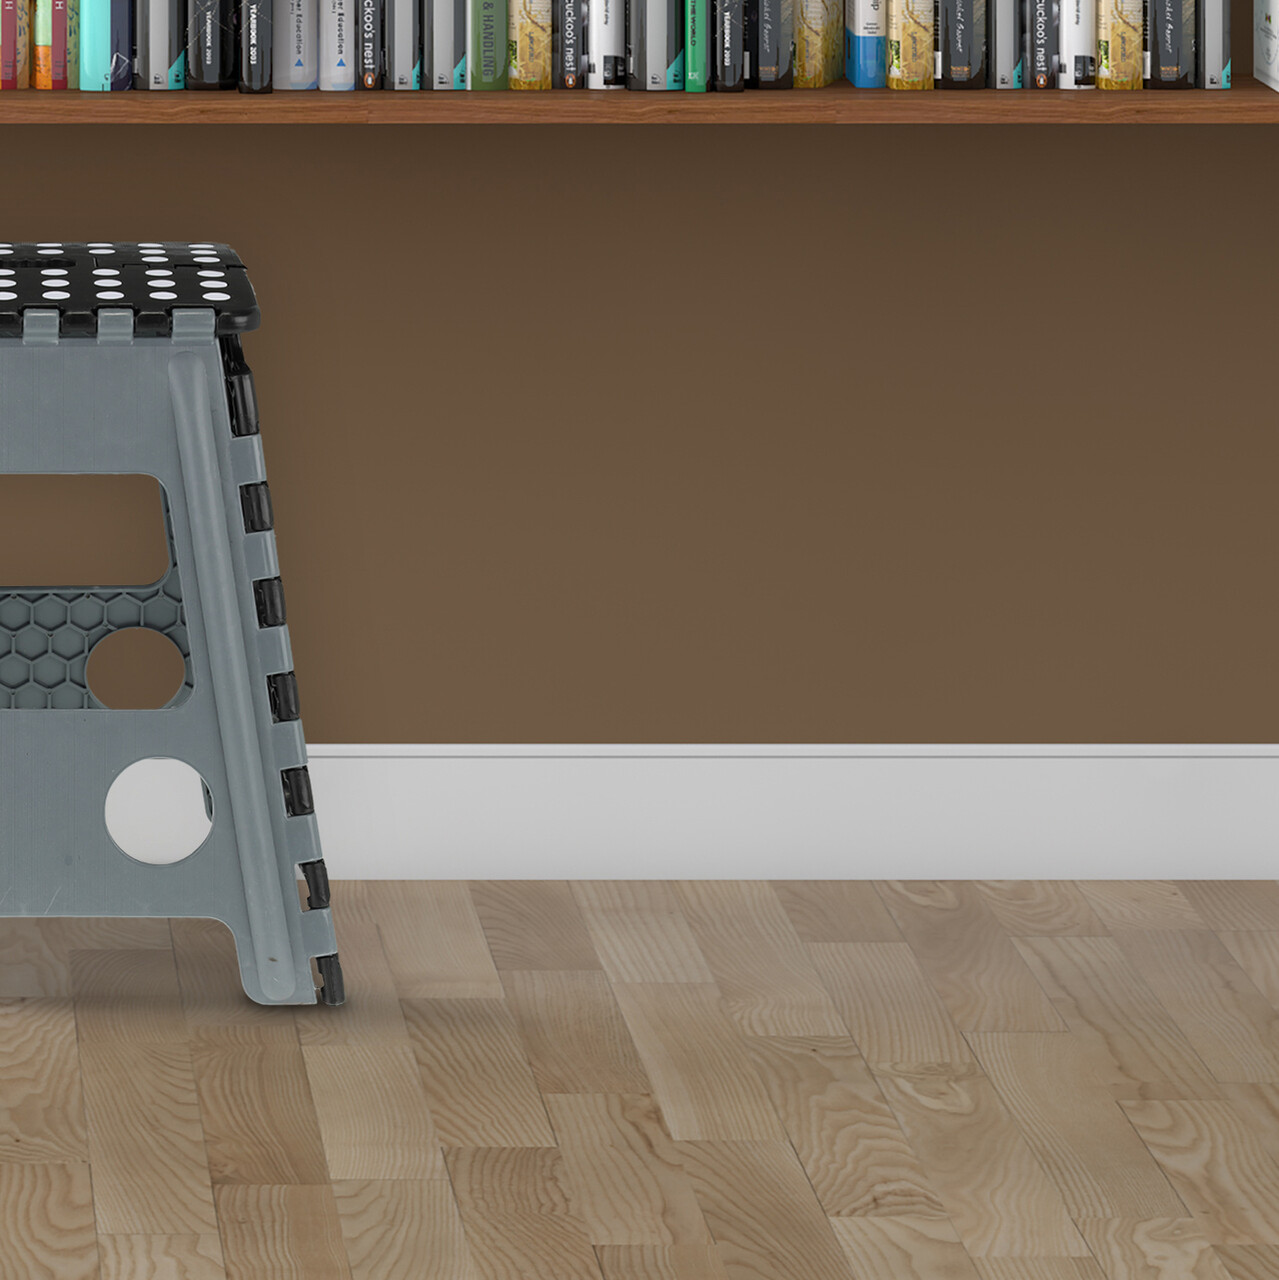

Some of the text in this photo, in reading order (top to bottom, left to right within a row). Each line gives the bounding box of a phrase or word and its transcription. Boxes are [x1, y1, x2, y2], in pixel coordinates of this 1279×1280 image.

[483, 2, 494, 10] &
[364, 43, 374, 69] nest
[483, 14, 494, 76] HANDLING
